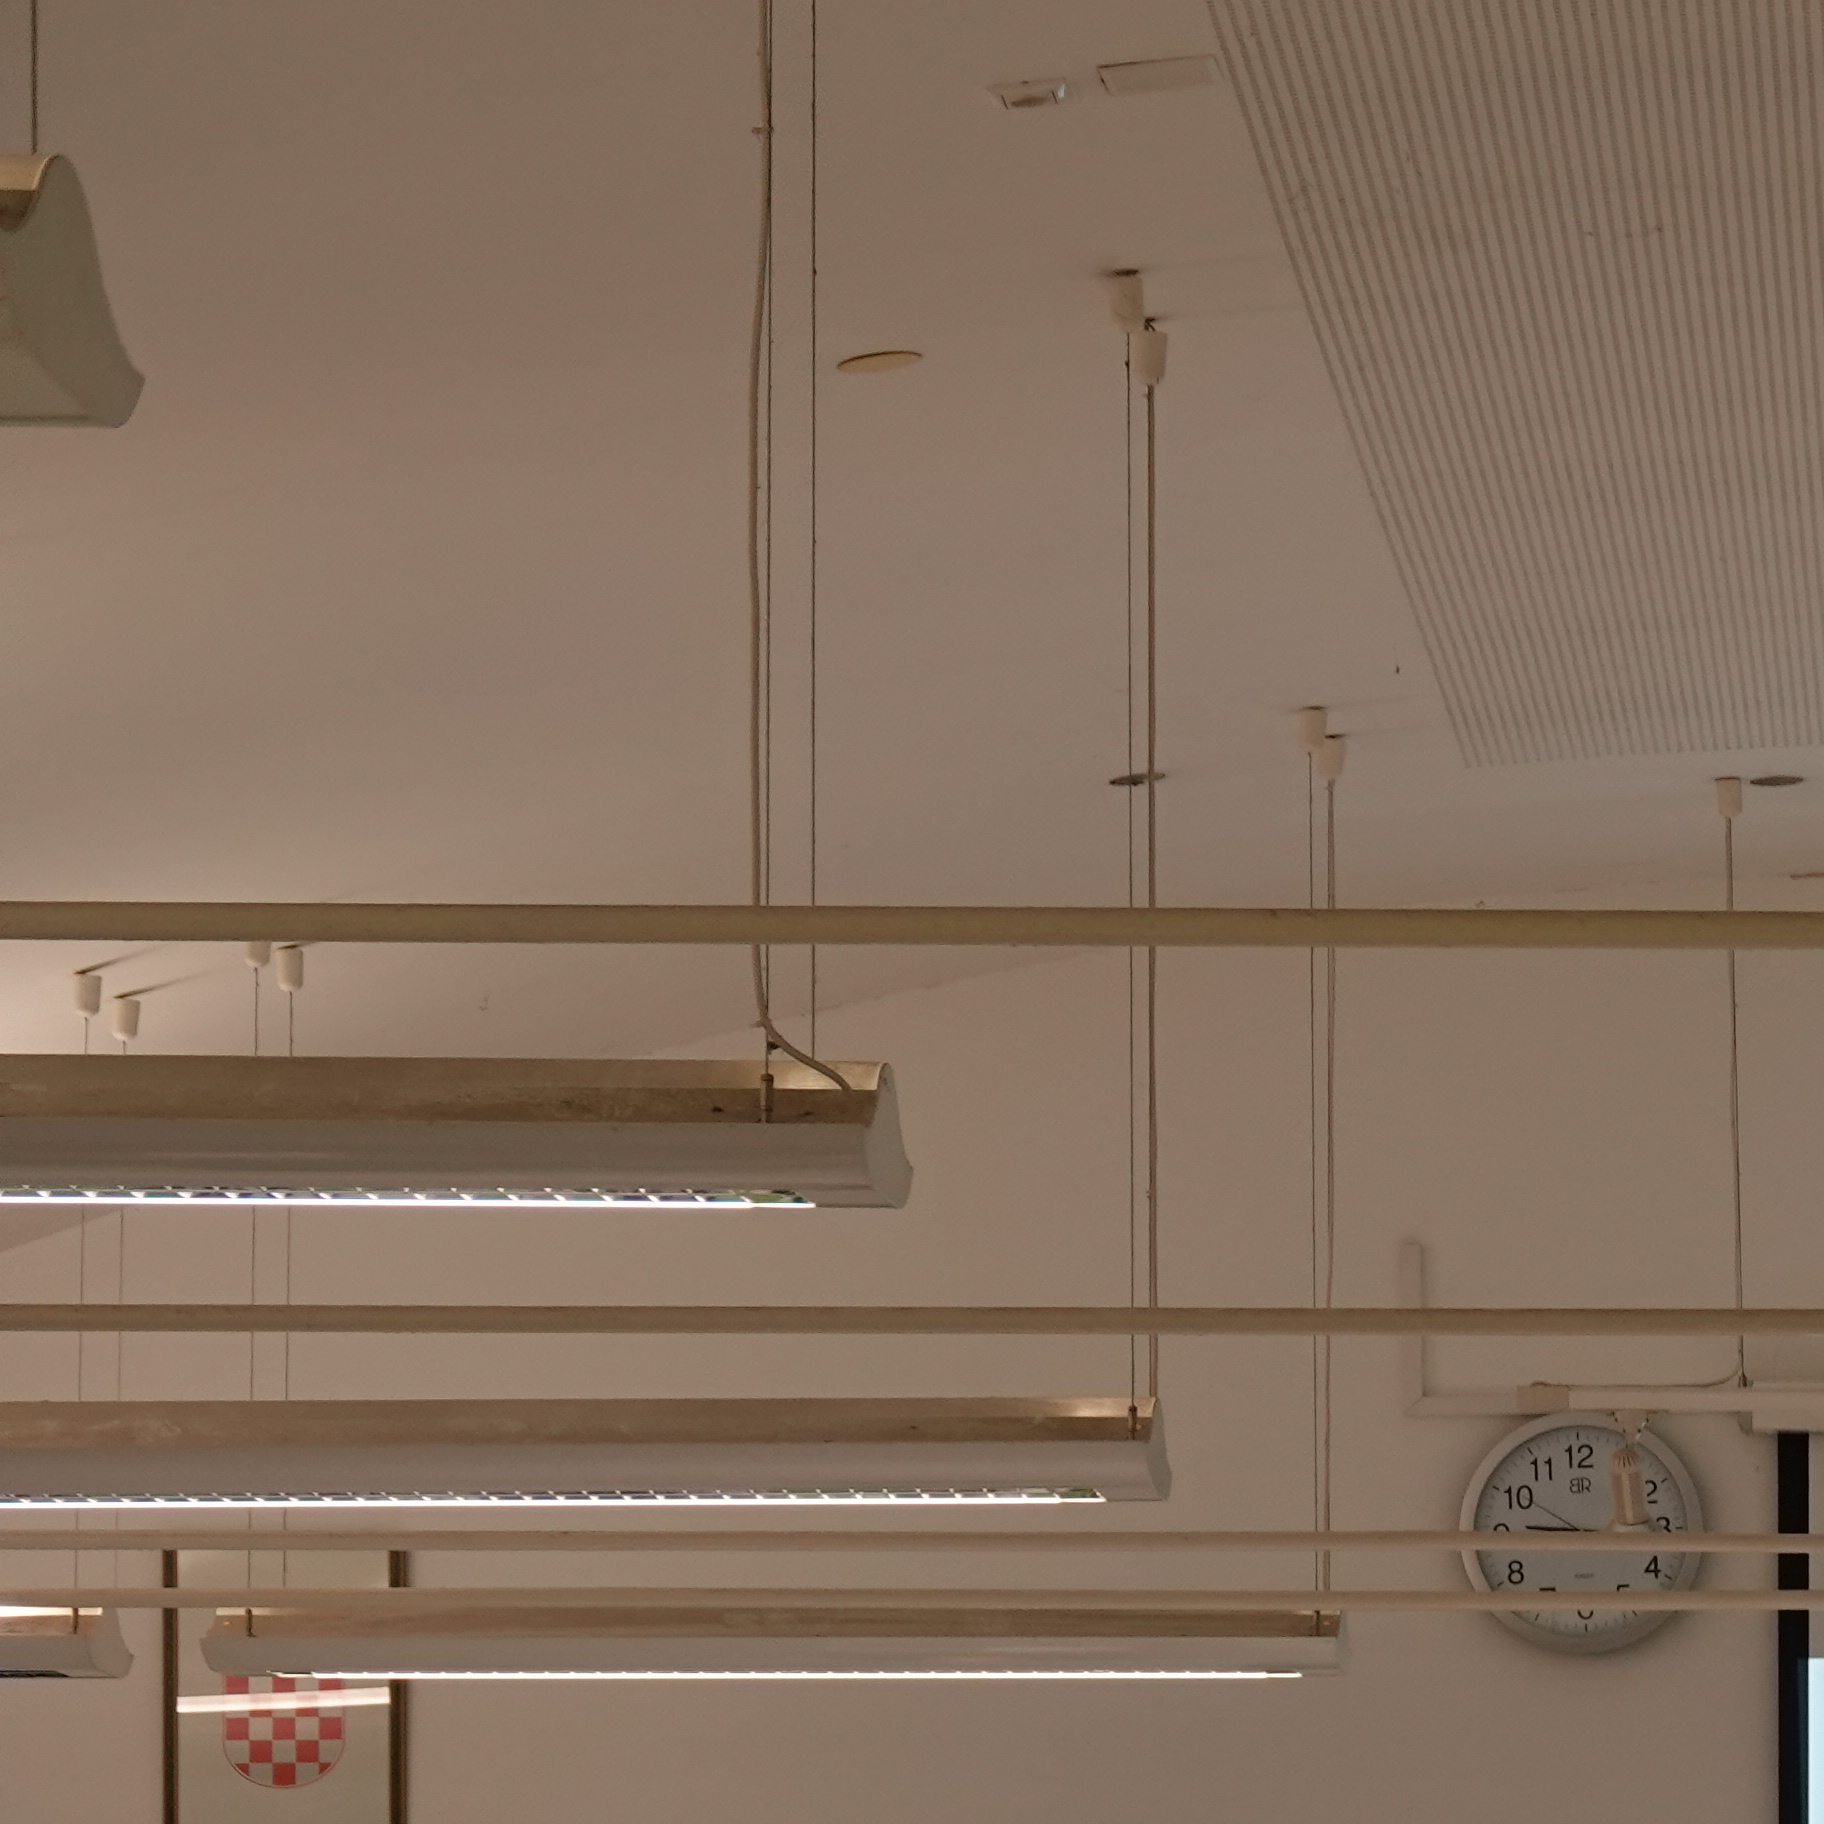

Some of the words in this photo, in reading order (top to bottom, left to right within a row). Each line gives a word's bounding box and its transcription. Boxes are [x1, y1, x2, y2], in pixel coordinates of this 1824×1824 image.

[1565, 1444, 1594, 1468] 12
[1530, 1458, 1552, 1481] 11
[1504, 1485, 1533, 1510] 10
[1645, 1480, 1658, 1504] 2
[1508, 1560, 1524, 1584] 8
[1644, 1556, 1661, 1579] 4
